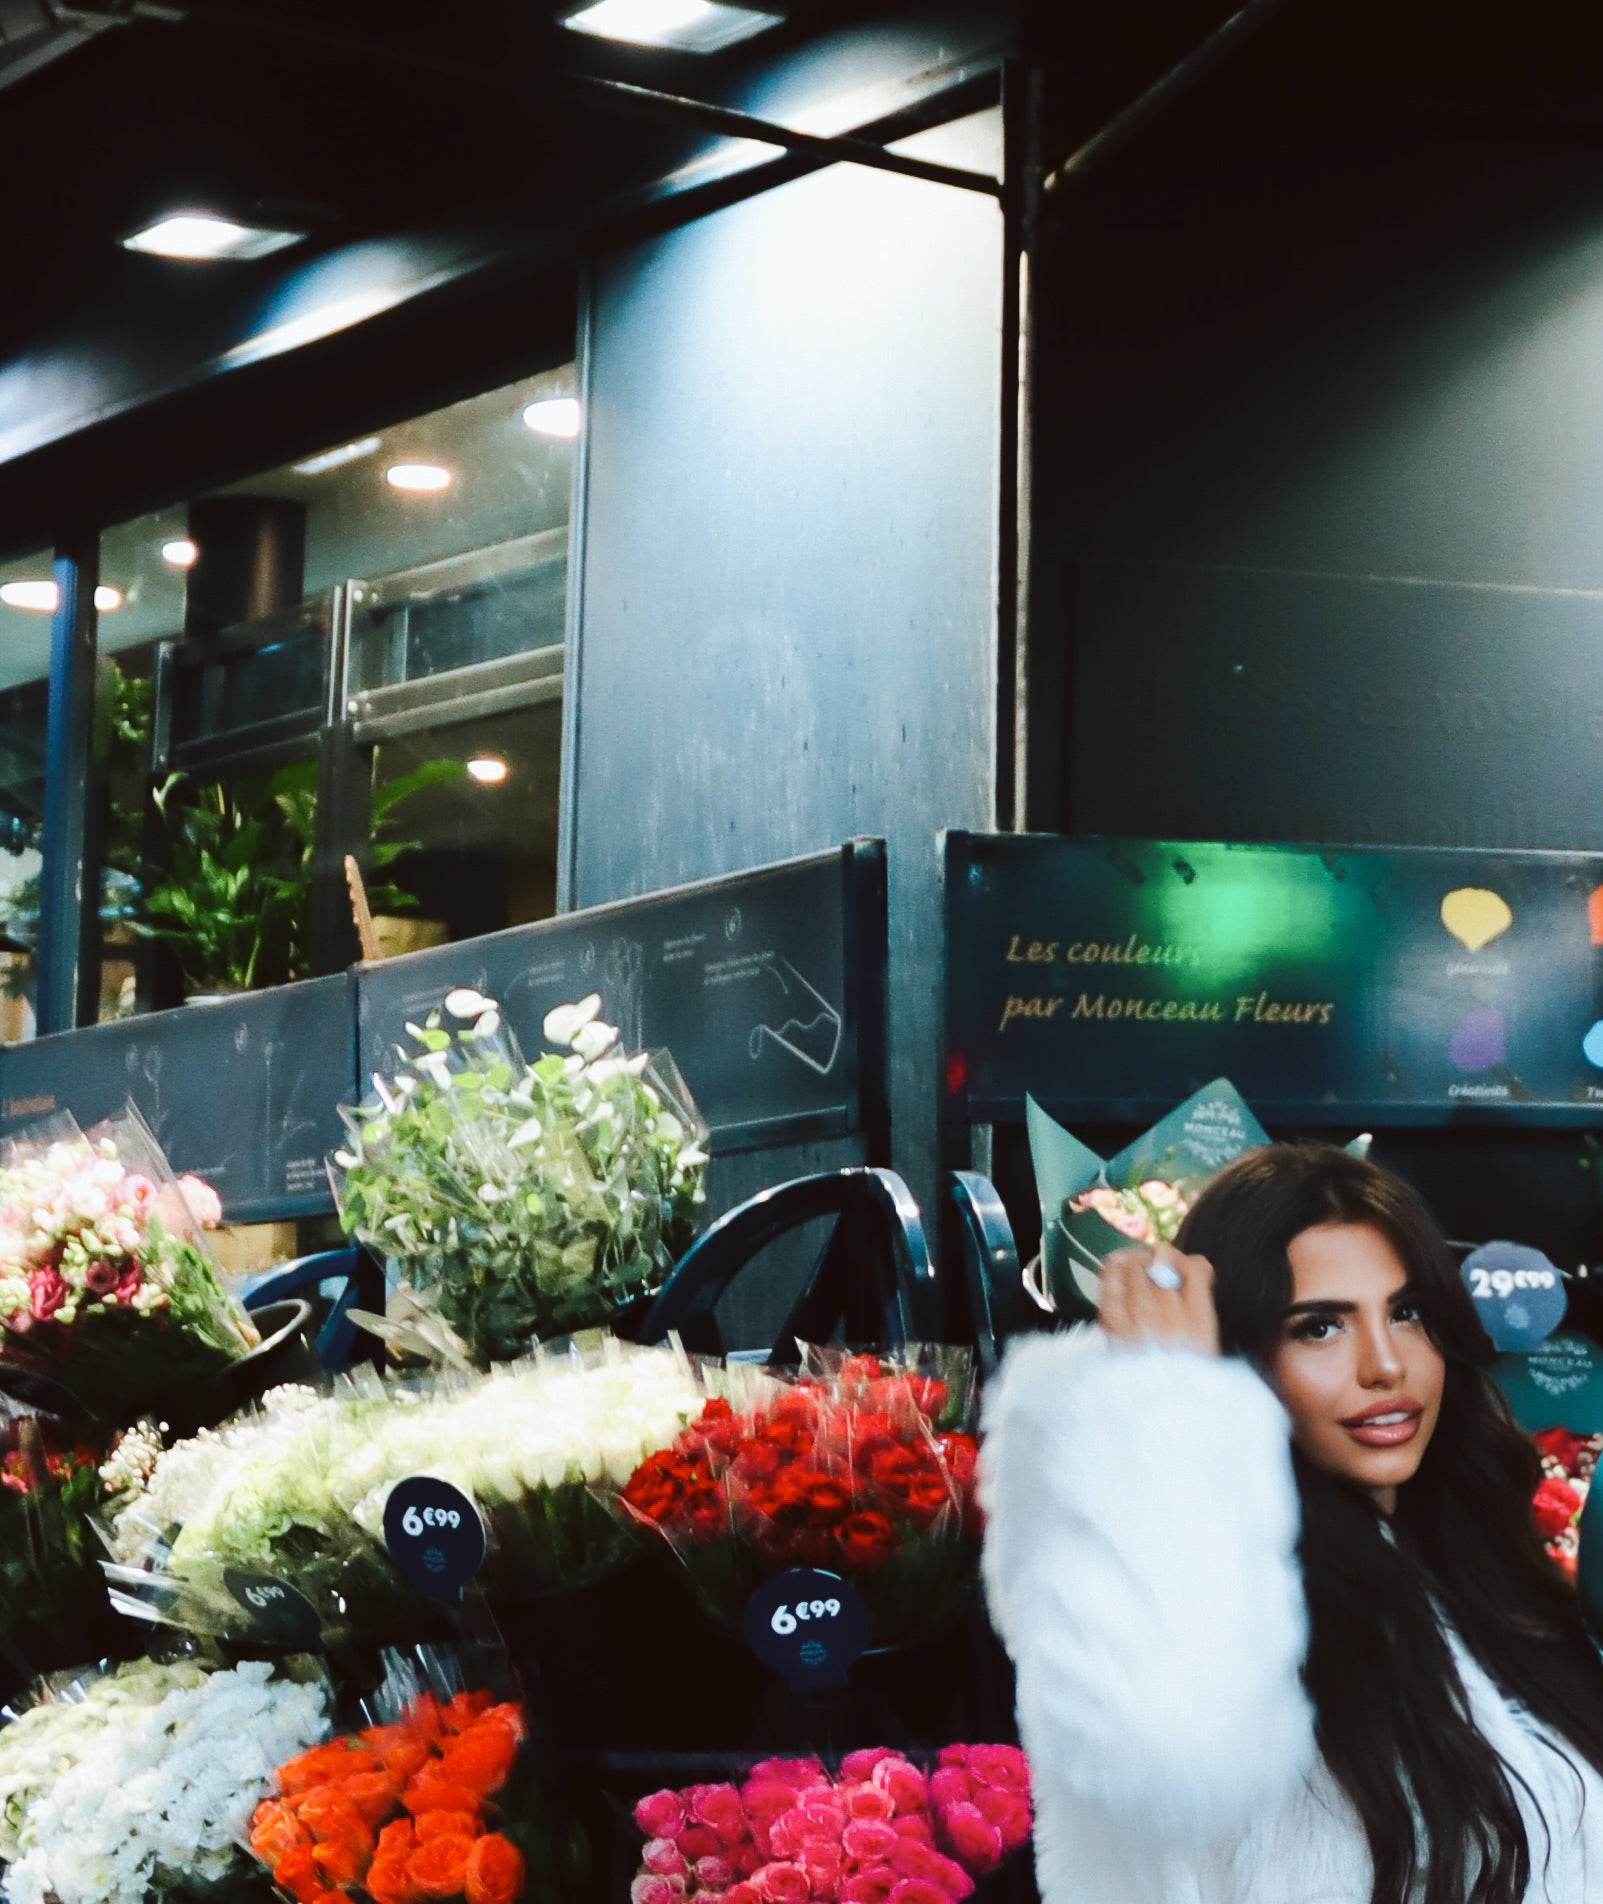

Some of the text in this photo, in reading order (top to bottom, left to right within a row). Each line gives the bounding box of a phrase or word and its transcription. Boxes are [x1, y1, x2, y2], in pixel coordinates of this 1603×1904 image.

[1005, 934, 1057, 963] Les
[999, 991, 1335, 1032] par Monceau Fleurs
[402, 1506, 461, 1536] 6€99
[771, 1598, 841, 1635] 6€99
